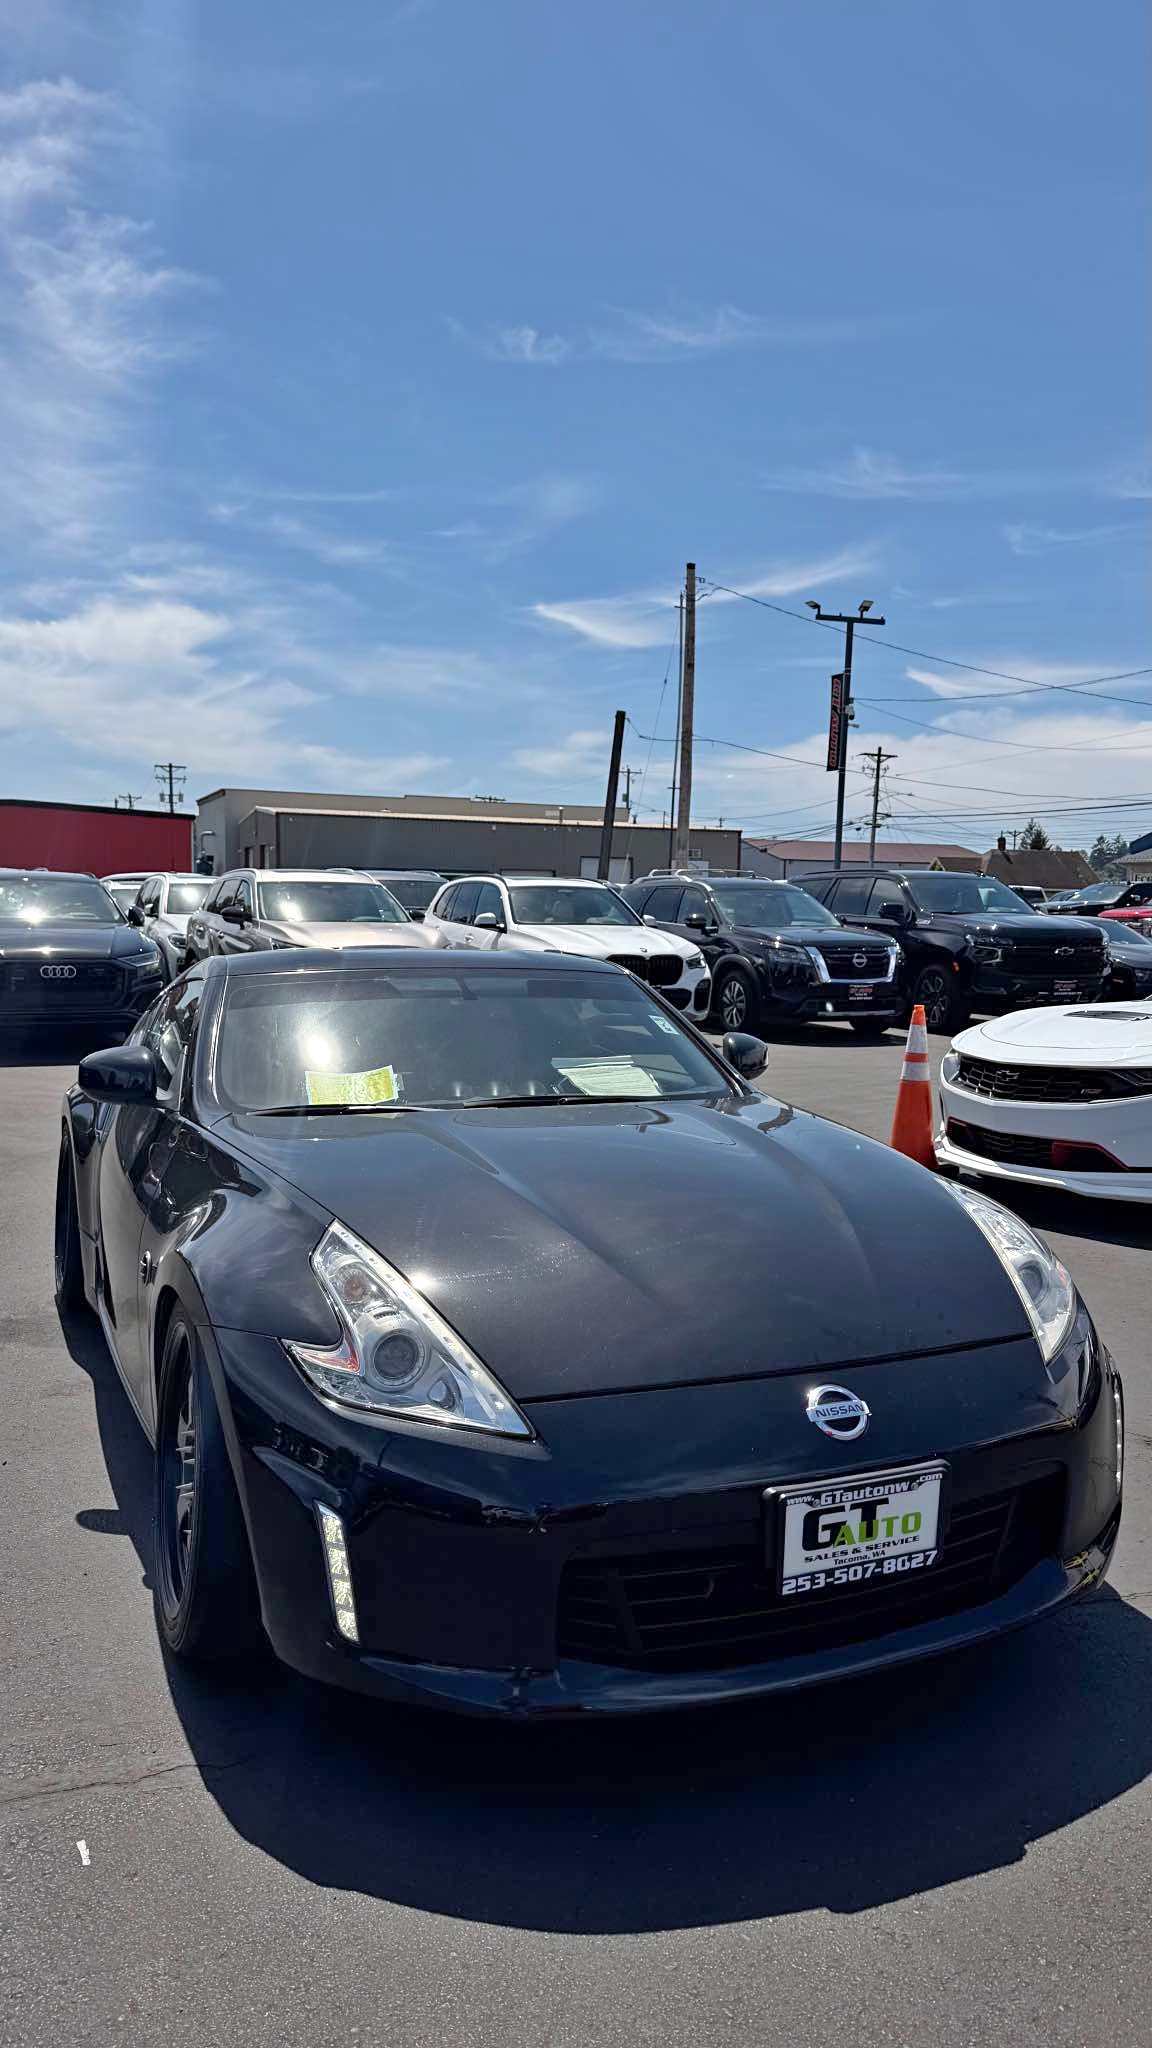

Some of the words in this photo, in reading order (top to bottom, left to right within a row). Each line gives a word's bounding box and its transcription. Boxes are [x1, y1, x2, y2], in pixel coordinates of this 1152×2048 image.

[815, 1403, 865, 1418] NISSAN
[802, 1498, 889, 1551] GT
[833, 1511, 922, 1548] AUTO
[804, 1548, 849, 1563] SALES
[851, 1546, 863, 1554] &
[865, 1535, 920, 1551] SERVICE
[834, 1552, 870, 1566] Tacoma,
[873, 1550, 886, 1558] WA
[782, 1550, 938, 1596] 253-507-8027
